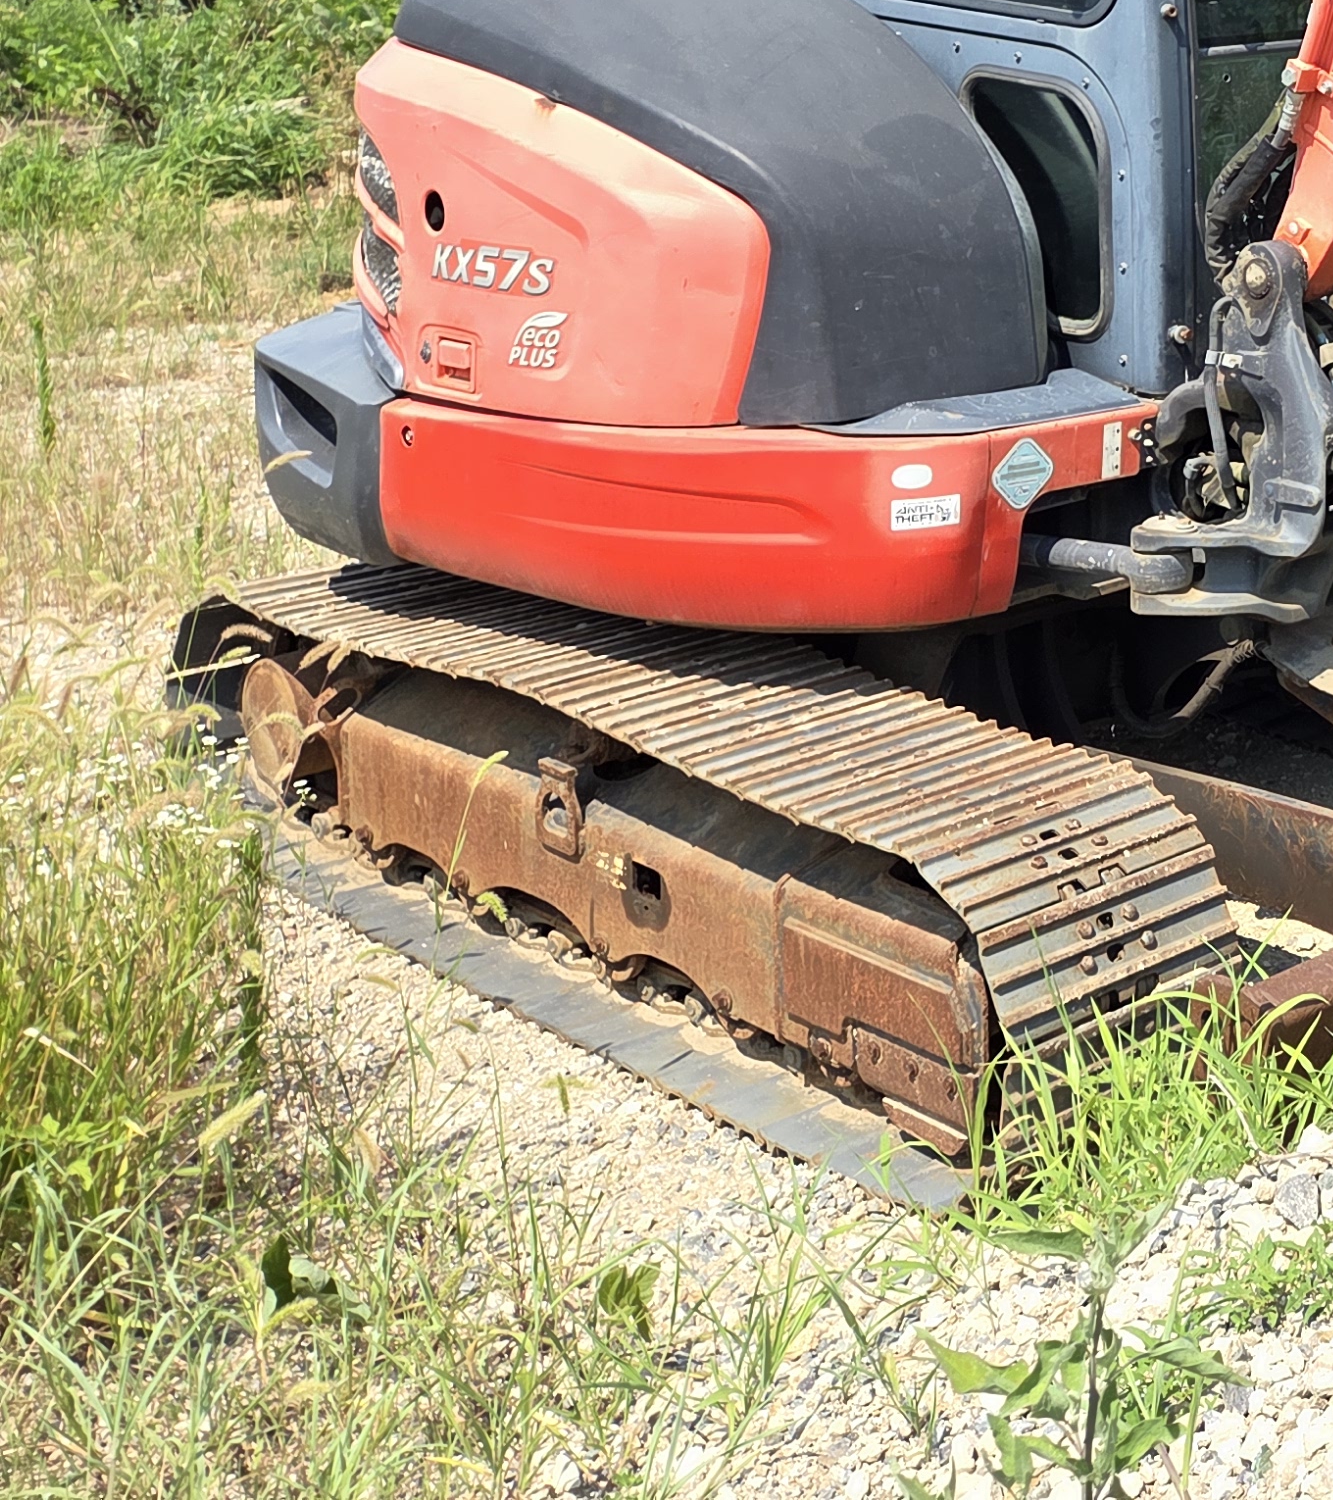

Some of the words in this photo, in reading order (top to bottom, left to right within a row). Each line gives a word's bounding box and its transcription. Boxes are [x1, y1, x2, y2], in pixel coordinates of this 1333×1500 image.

[431, 243, 556, 296] KX57S
[521, 328, 561, 348] eco
[508, 345, 558, 368] PLUS
[895, 512, 935, 524] THEFT
